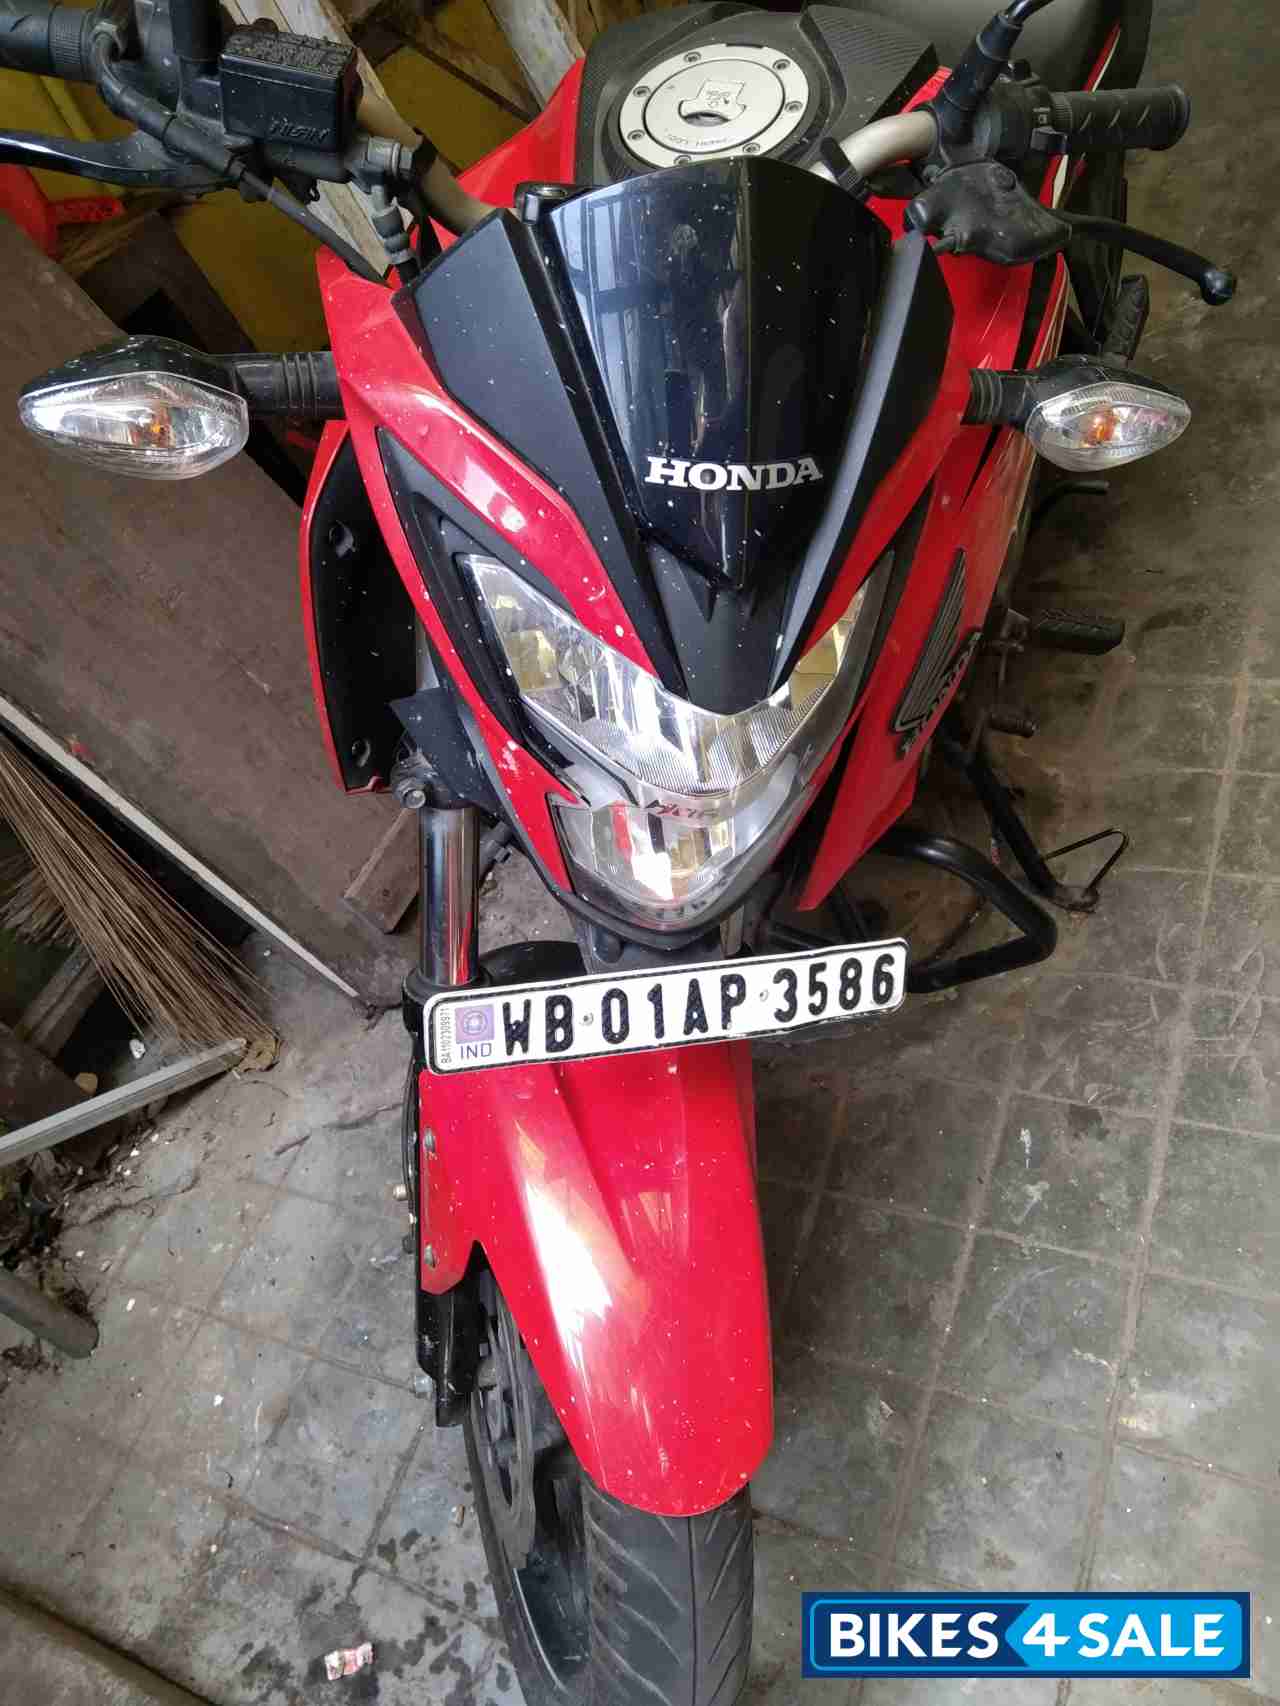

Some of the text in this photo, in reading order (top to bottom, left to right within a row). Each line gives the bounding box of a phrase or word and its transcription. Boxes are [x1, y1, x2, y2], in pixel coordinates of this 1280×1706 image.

[644, 456, 824, 491] HONDA
[502, 953, 895, 1056] WB 01AP 3586
[460, 1042, 493, 1060] IND
